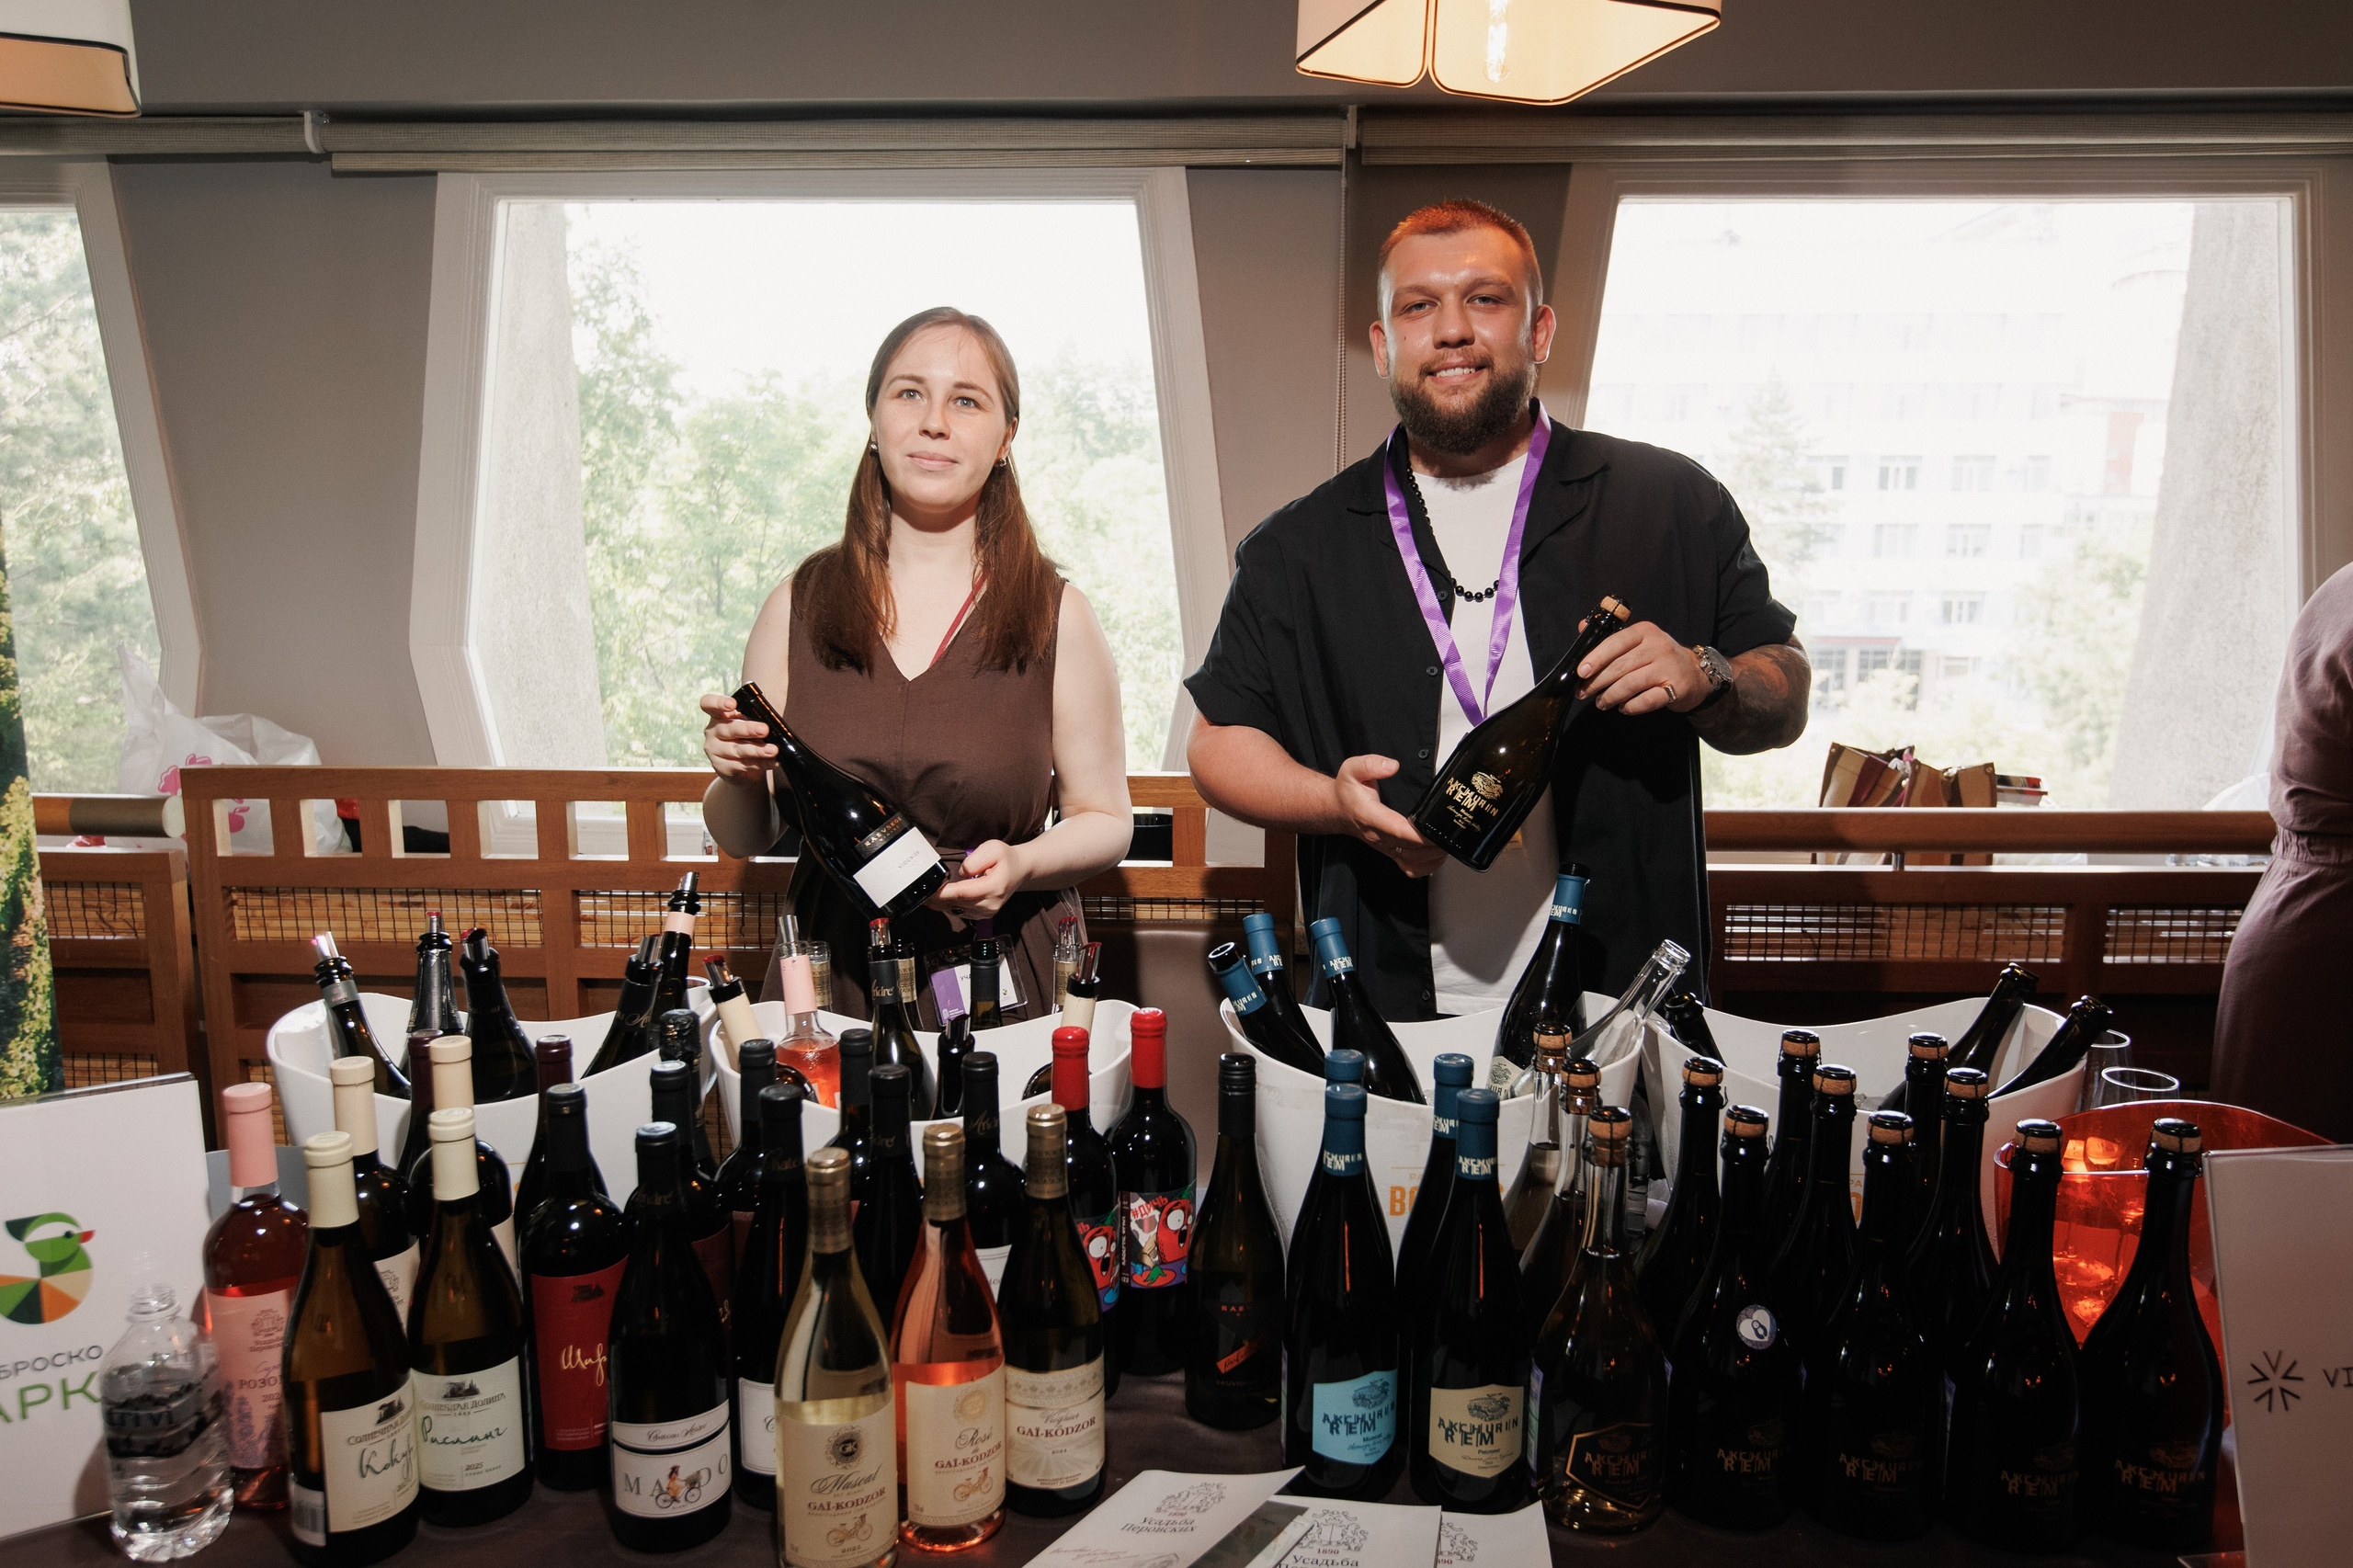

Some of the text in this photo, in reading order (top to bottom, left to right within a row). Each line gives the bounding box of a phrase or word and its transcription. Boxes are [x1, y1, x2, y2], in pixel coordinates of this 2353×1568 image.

[1131, 1196, 1168, 1220] #ДИЧЬ
[239, 1375, 283, 1391] РОЗО
[262, 1392, 284, 1403] 202
[421, 1415, 508, 1445] Рислинг
[1438, 1416, 1518, 1435] AKCHURIN
[1120, 1523, 1197, 1534] Перовских
[1141, 1517, 1196, 1527] Усадьба
[1292, 1555, 1358, 1567] Усадьба
